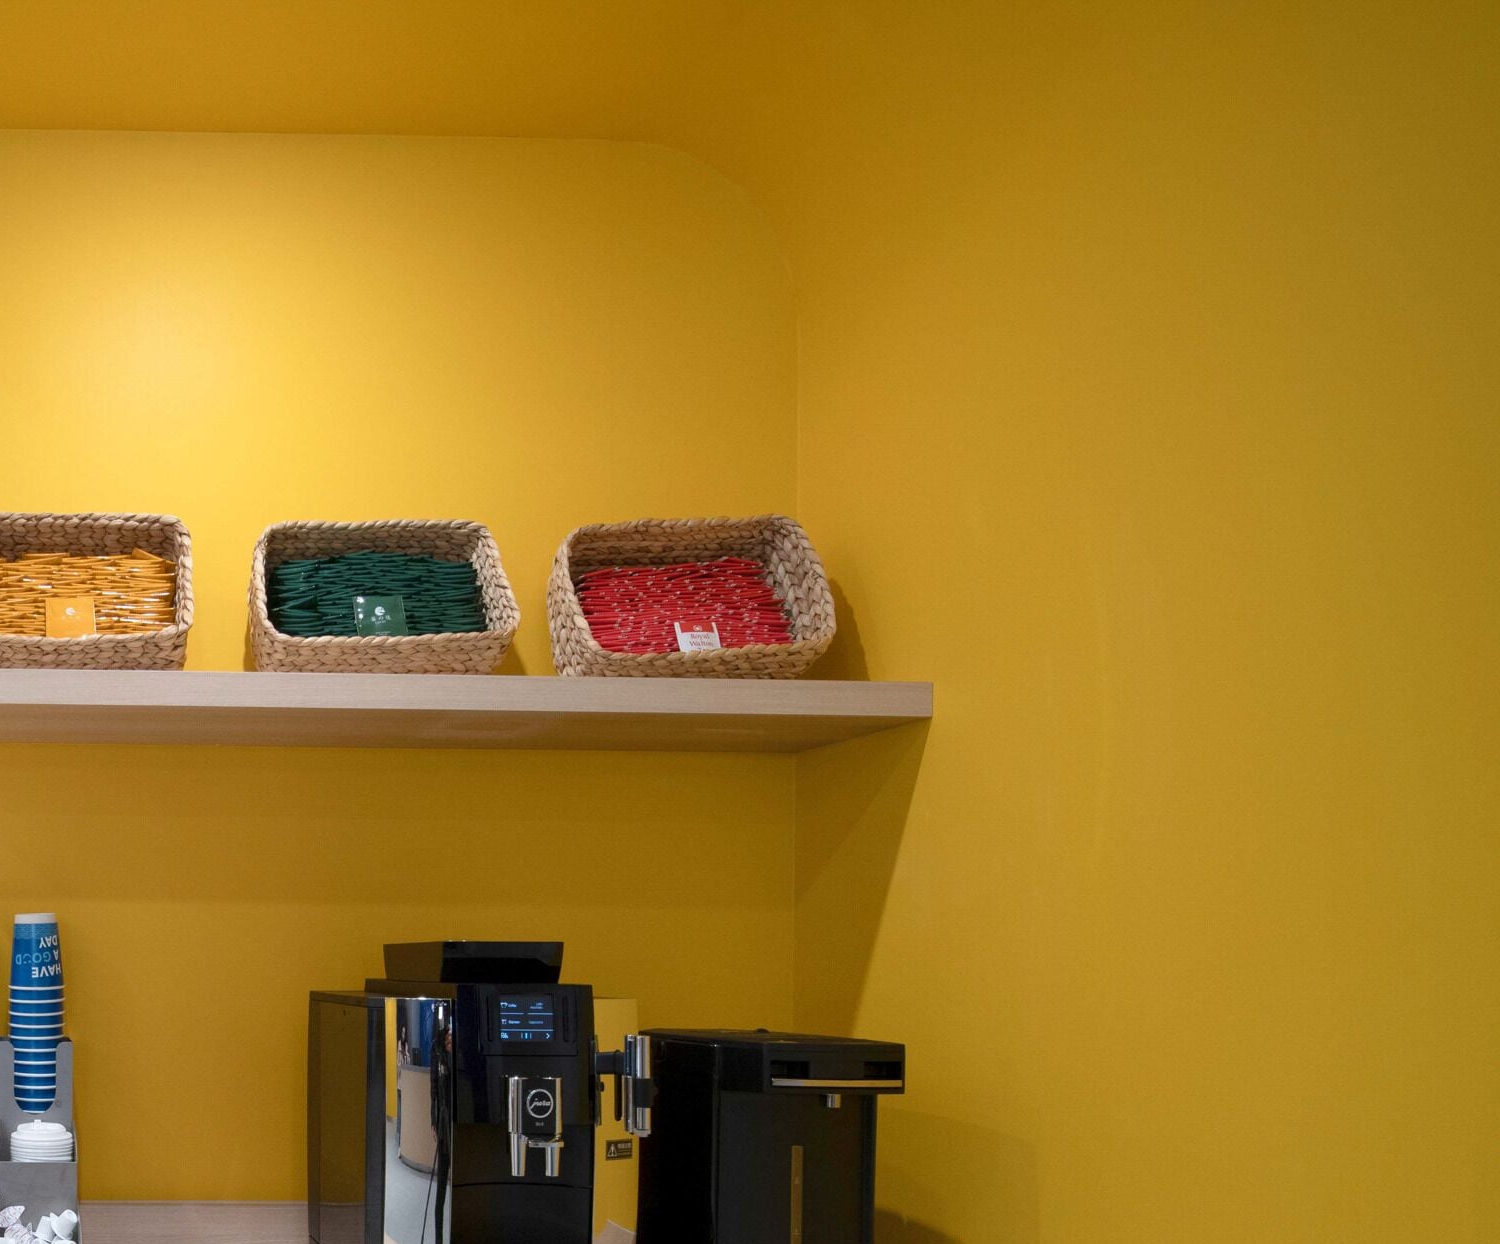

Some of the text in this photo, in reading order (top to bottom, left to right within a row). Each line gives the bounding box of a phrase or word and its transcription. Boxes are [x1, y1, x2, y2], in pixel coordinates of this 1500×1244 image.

[690, 633, 710, 641] Royal
[39, 935, 58, 948] DAY
[53, 949, 59, 961] A
[31, 963, 62, 978] HAVE
[530, 1098, 551, 1109] jura
